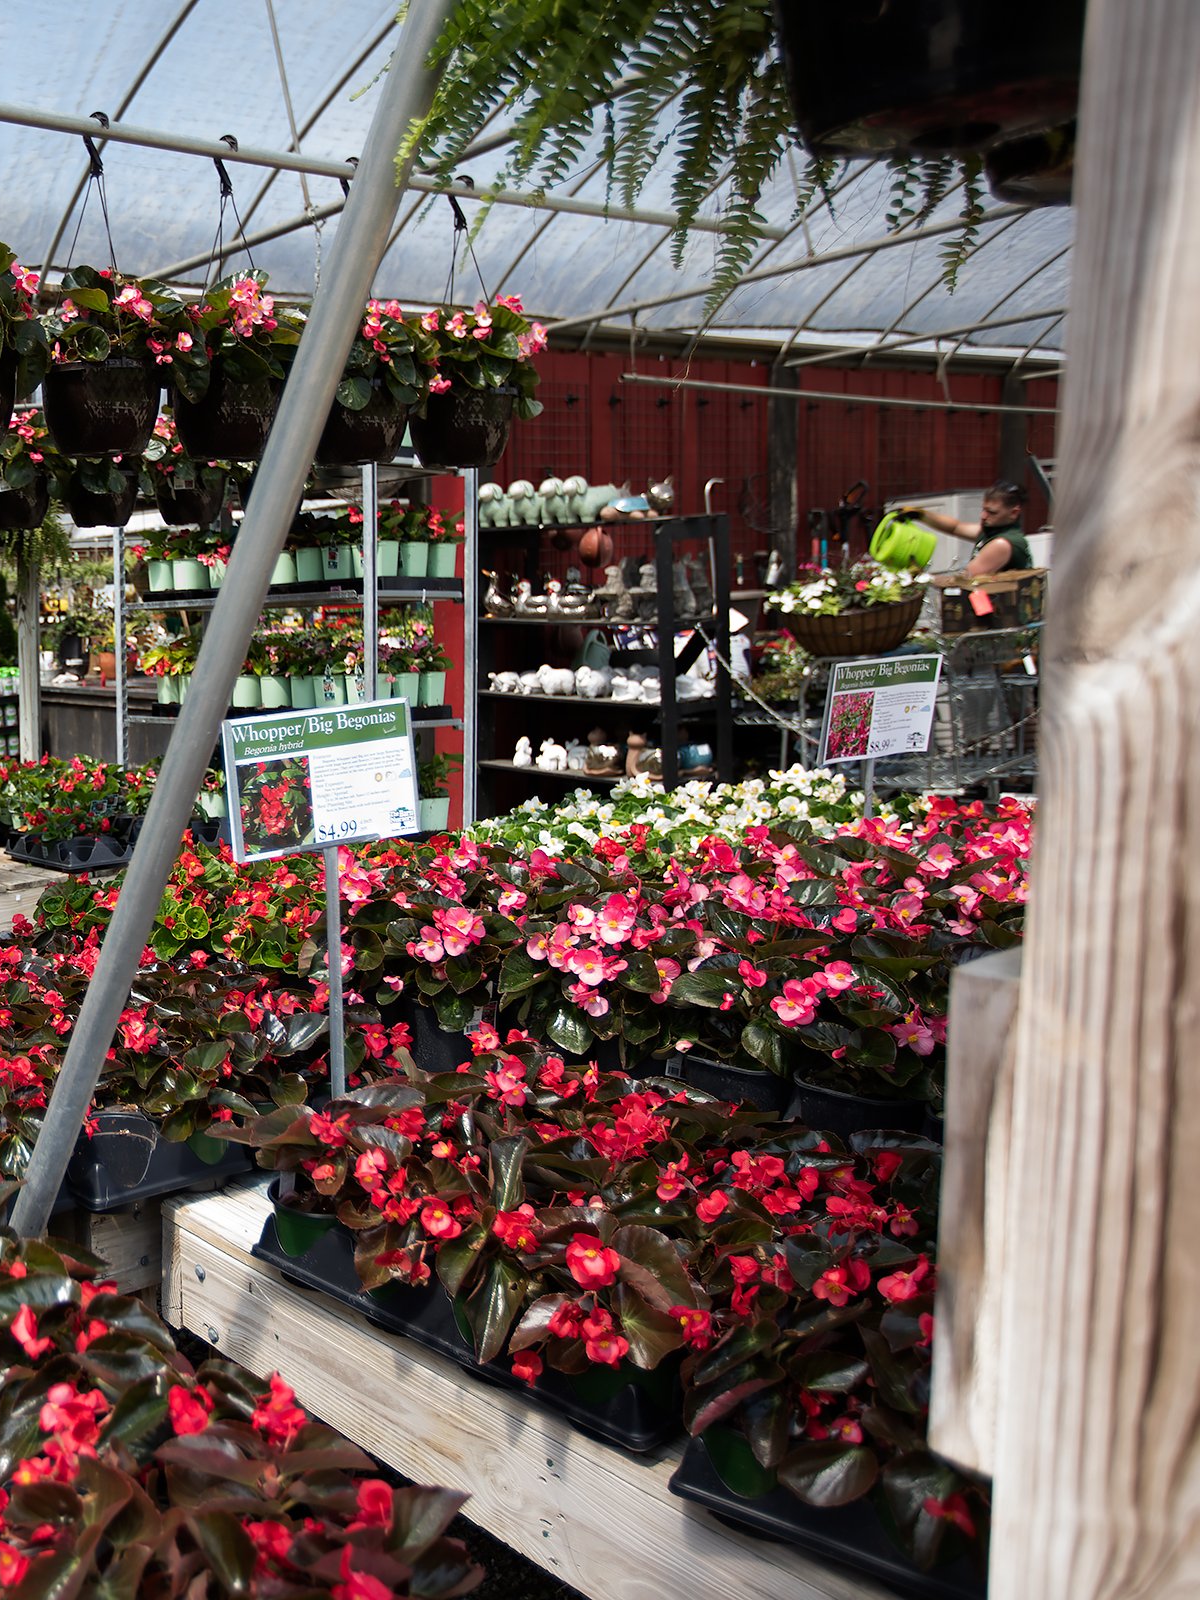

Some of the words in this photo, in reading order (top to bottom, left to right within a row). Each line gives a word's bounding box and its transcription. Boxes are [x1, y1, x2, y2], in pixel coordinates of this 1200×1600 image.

[837, 664, 893, 680] Whopper/Big
[894, 661, 930, 675] Begonias
[232, 717, 334, 743] Whopper/Big
[337, 709, 396, 729] Begonias
[244, 743, 277, 756] Begonia
[278, 740, 304, 753] hybrid
[869, 740, 890, 753] $8.99
[318, 820, 357, 840] $4.99
